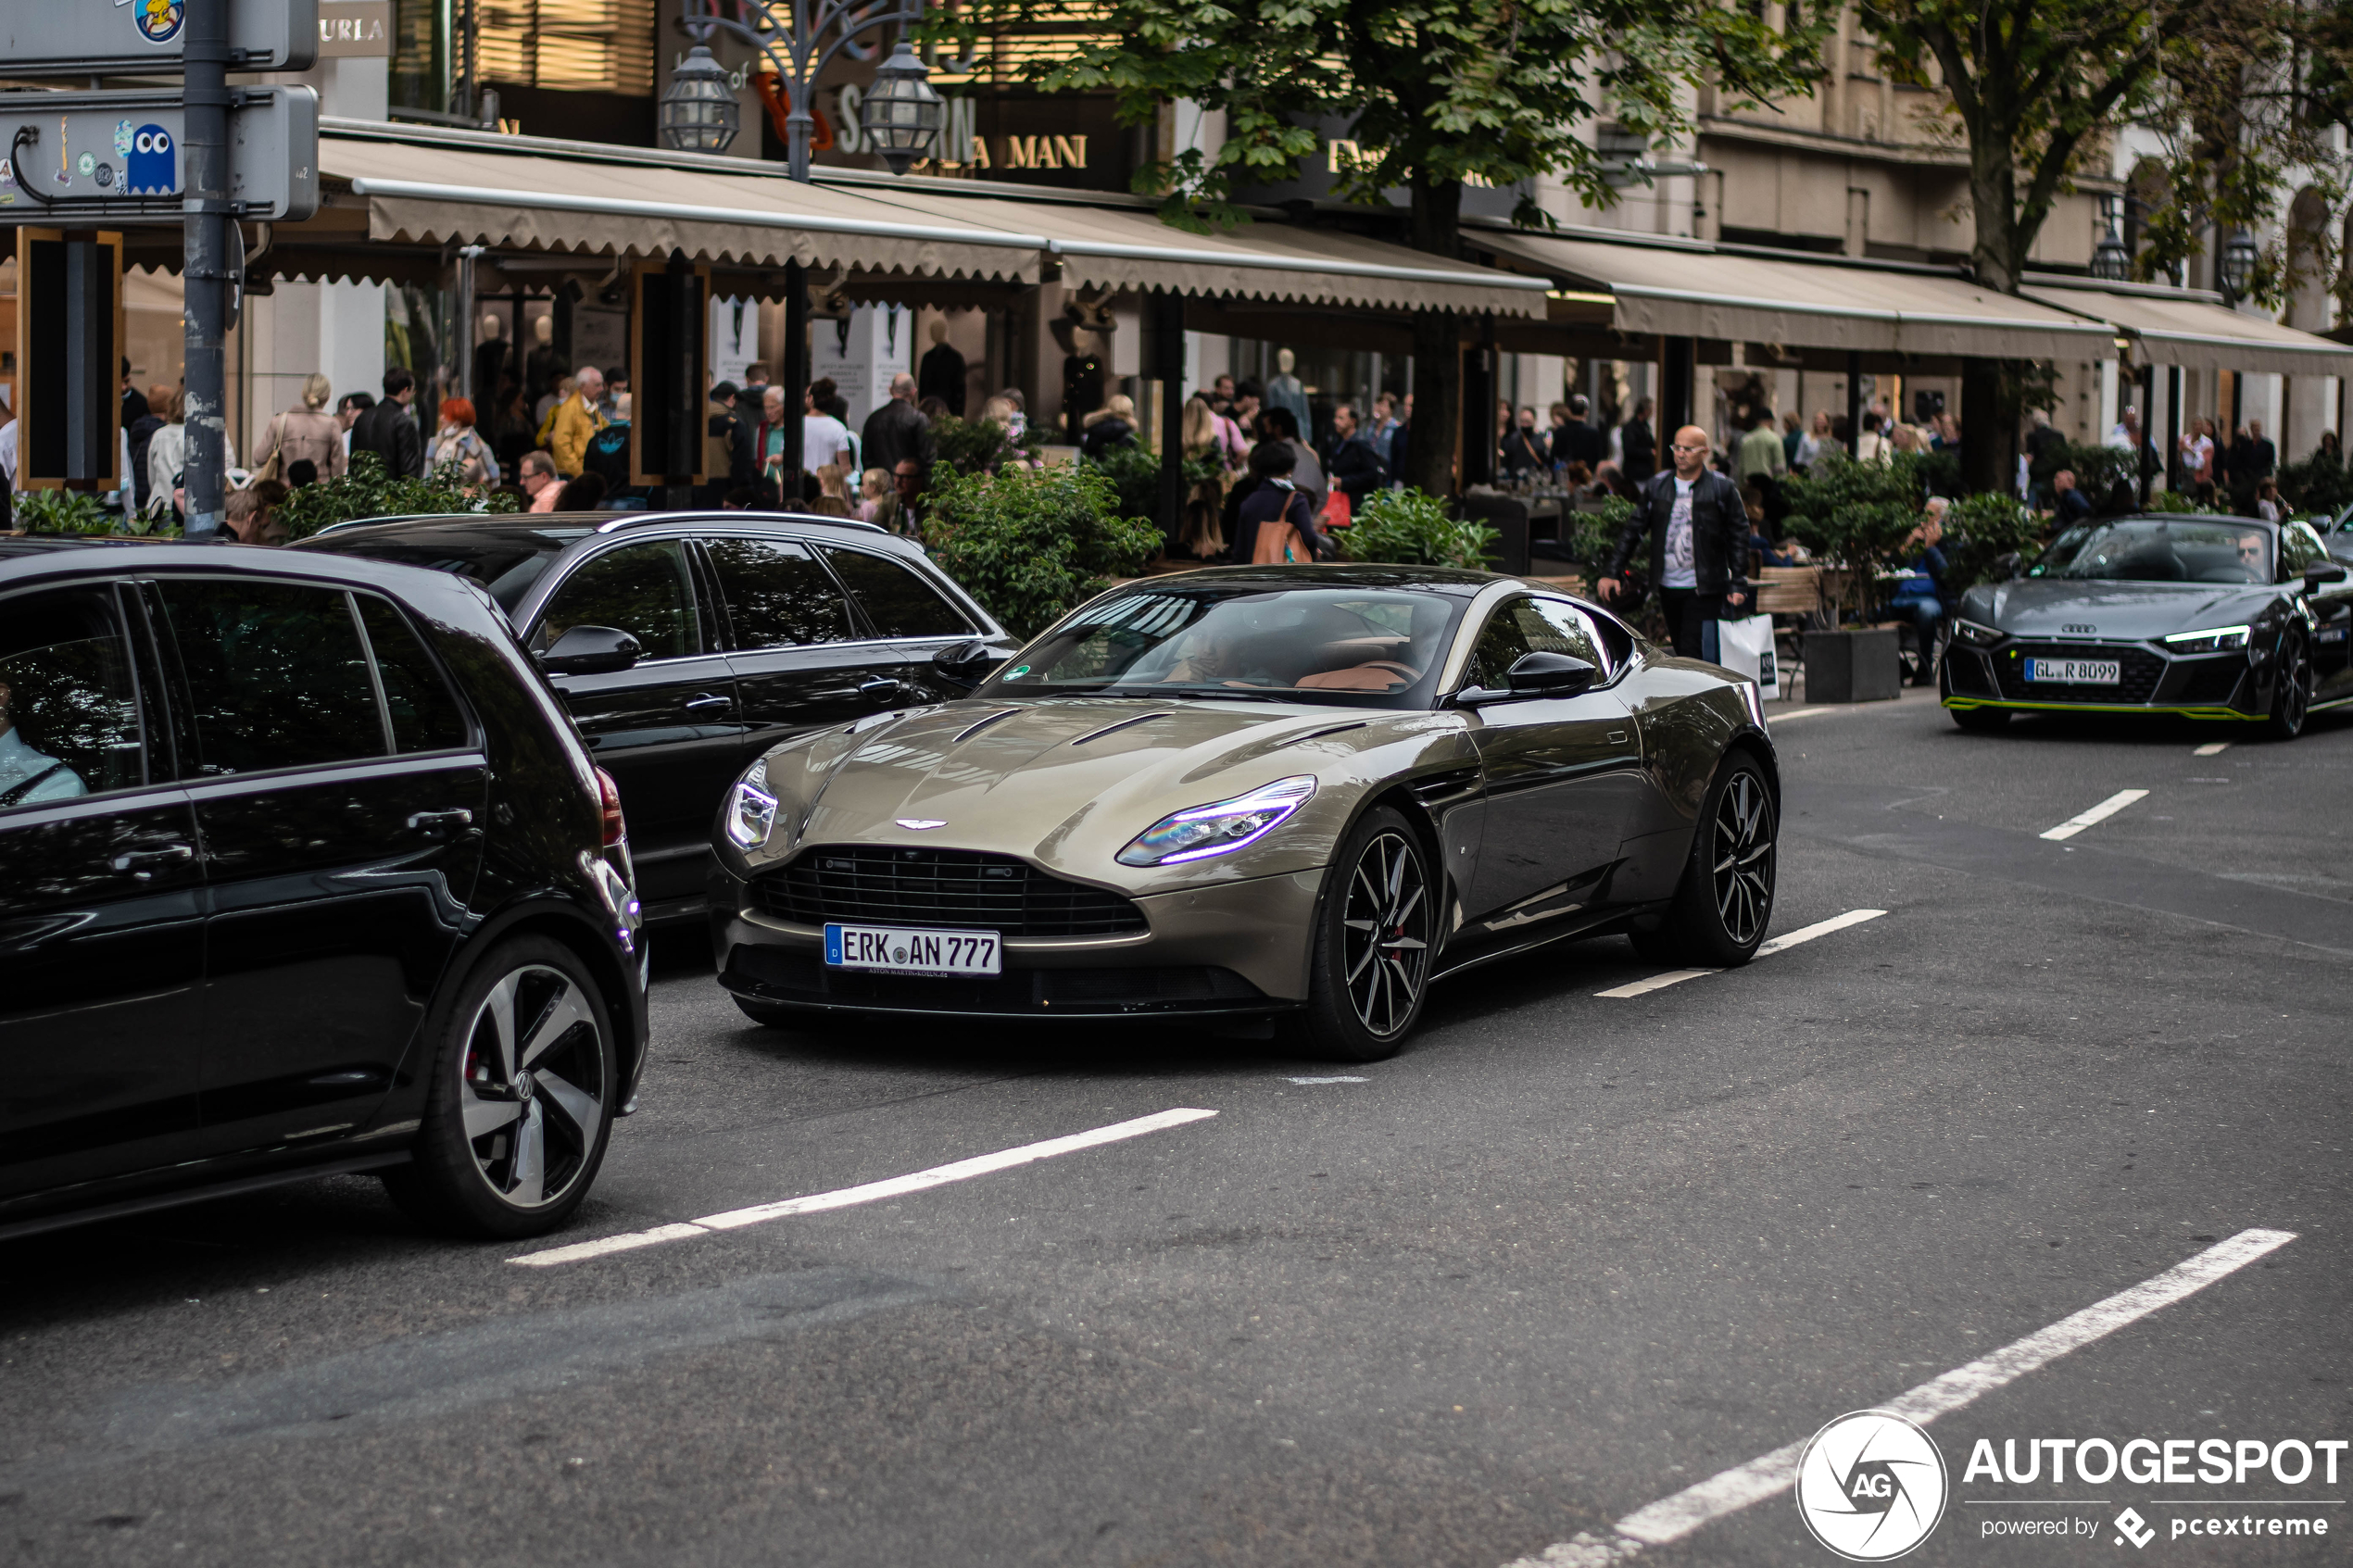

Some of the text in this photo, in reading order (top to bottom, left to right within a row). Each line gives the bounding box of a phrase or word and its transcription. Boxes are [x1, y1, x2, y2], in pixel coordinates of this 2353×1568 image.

[319, 19, 384, 42] URLA
[2035, 661, 2117, 681] GL R 8099
[844, 931, 995, 968] ERK AN 777
